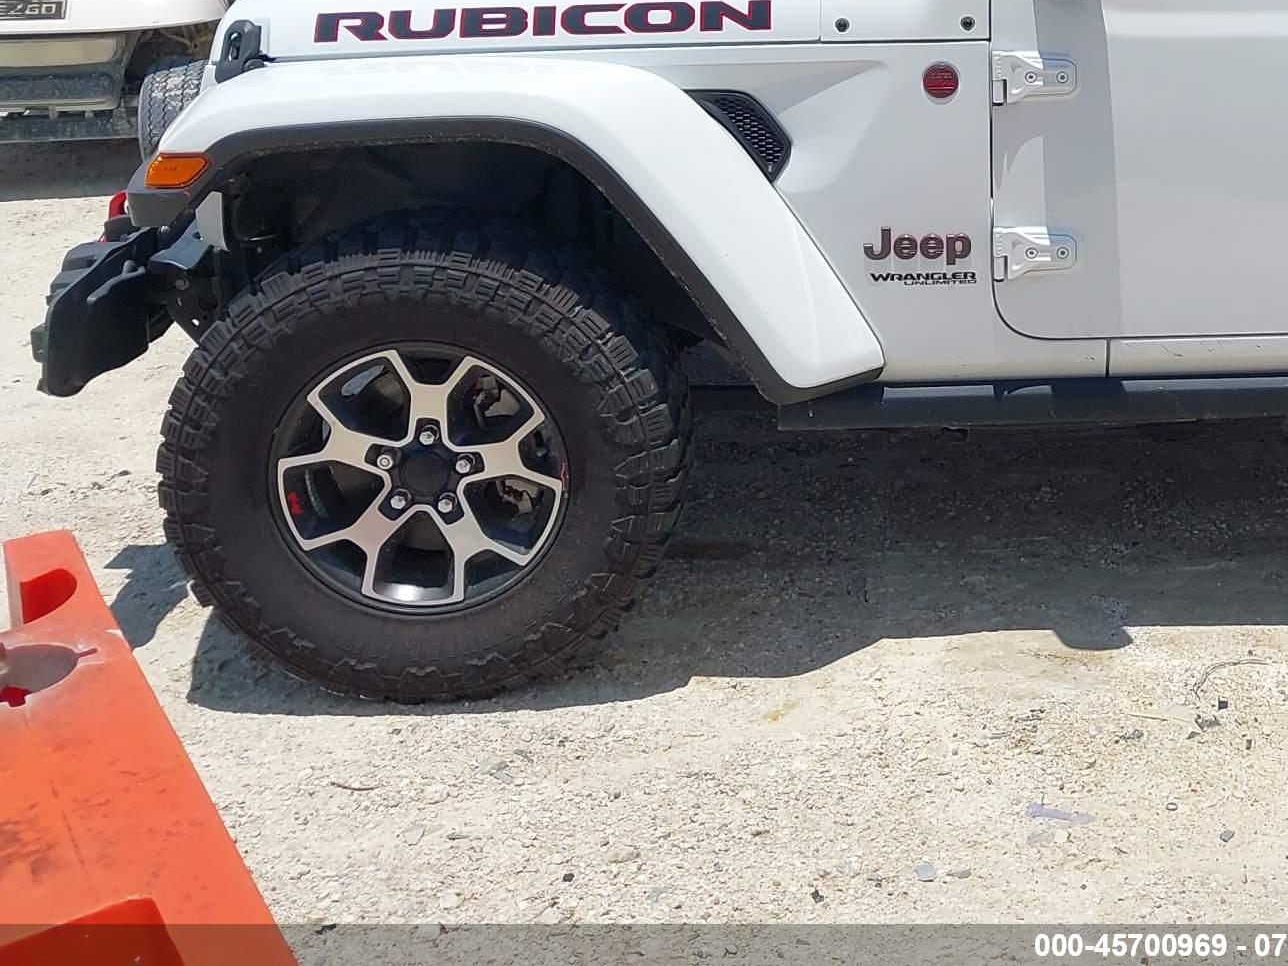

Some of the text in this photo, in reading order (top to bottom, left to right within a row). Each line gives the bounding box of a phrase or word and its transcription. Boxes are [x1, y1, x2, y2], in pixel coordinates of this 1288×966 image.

[313, 0, 772, 43] RUBICON
[863, 226, 972, 266] Jeep
[869, 272, 977, 282] WRANGLER
